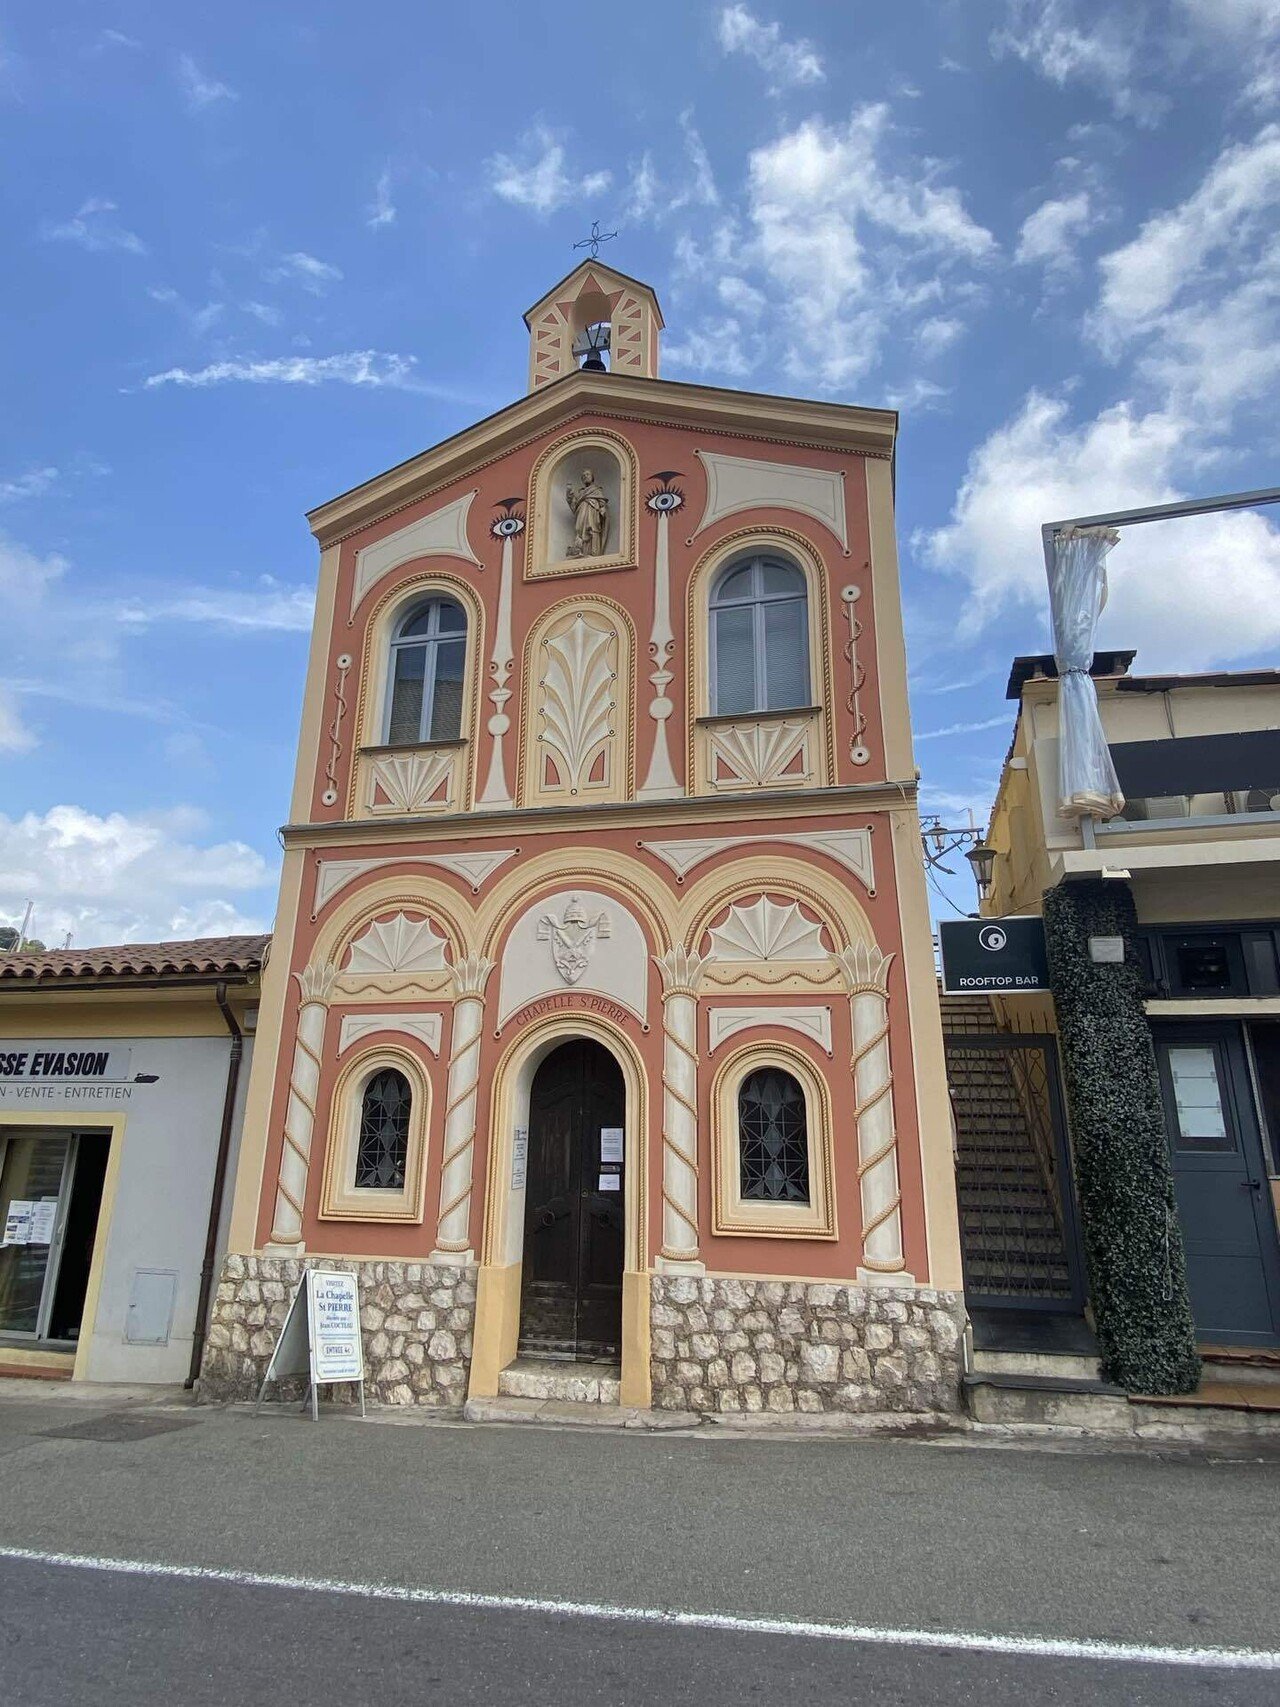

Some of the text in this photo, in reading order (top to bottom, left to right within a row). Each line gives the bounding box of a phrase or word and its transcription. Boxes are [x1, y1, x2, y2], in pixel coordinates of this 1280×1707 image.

[959, 975, 1039, 987] ROOFTOP BAR
[516, 996, 574, 1026] CHAPELLE
[590, 998, 630, 1027] PIERRE
[29, 1052, 110, 1076] EVASION
[16, 1086, 55, 1098] VENTE
[64, 1087, 132, 1099] ENTRETIEN
[316, 1290, 354, 1302] La Chapelle
[327, 1303, 353, 1312] PIERRE
